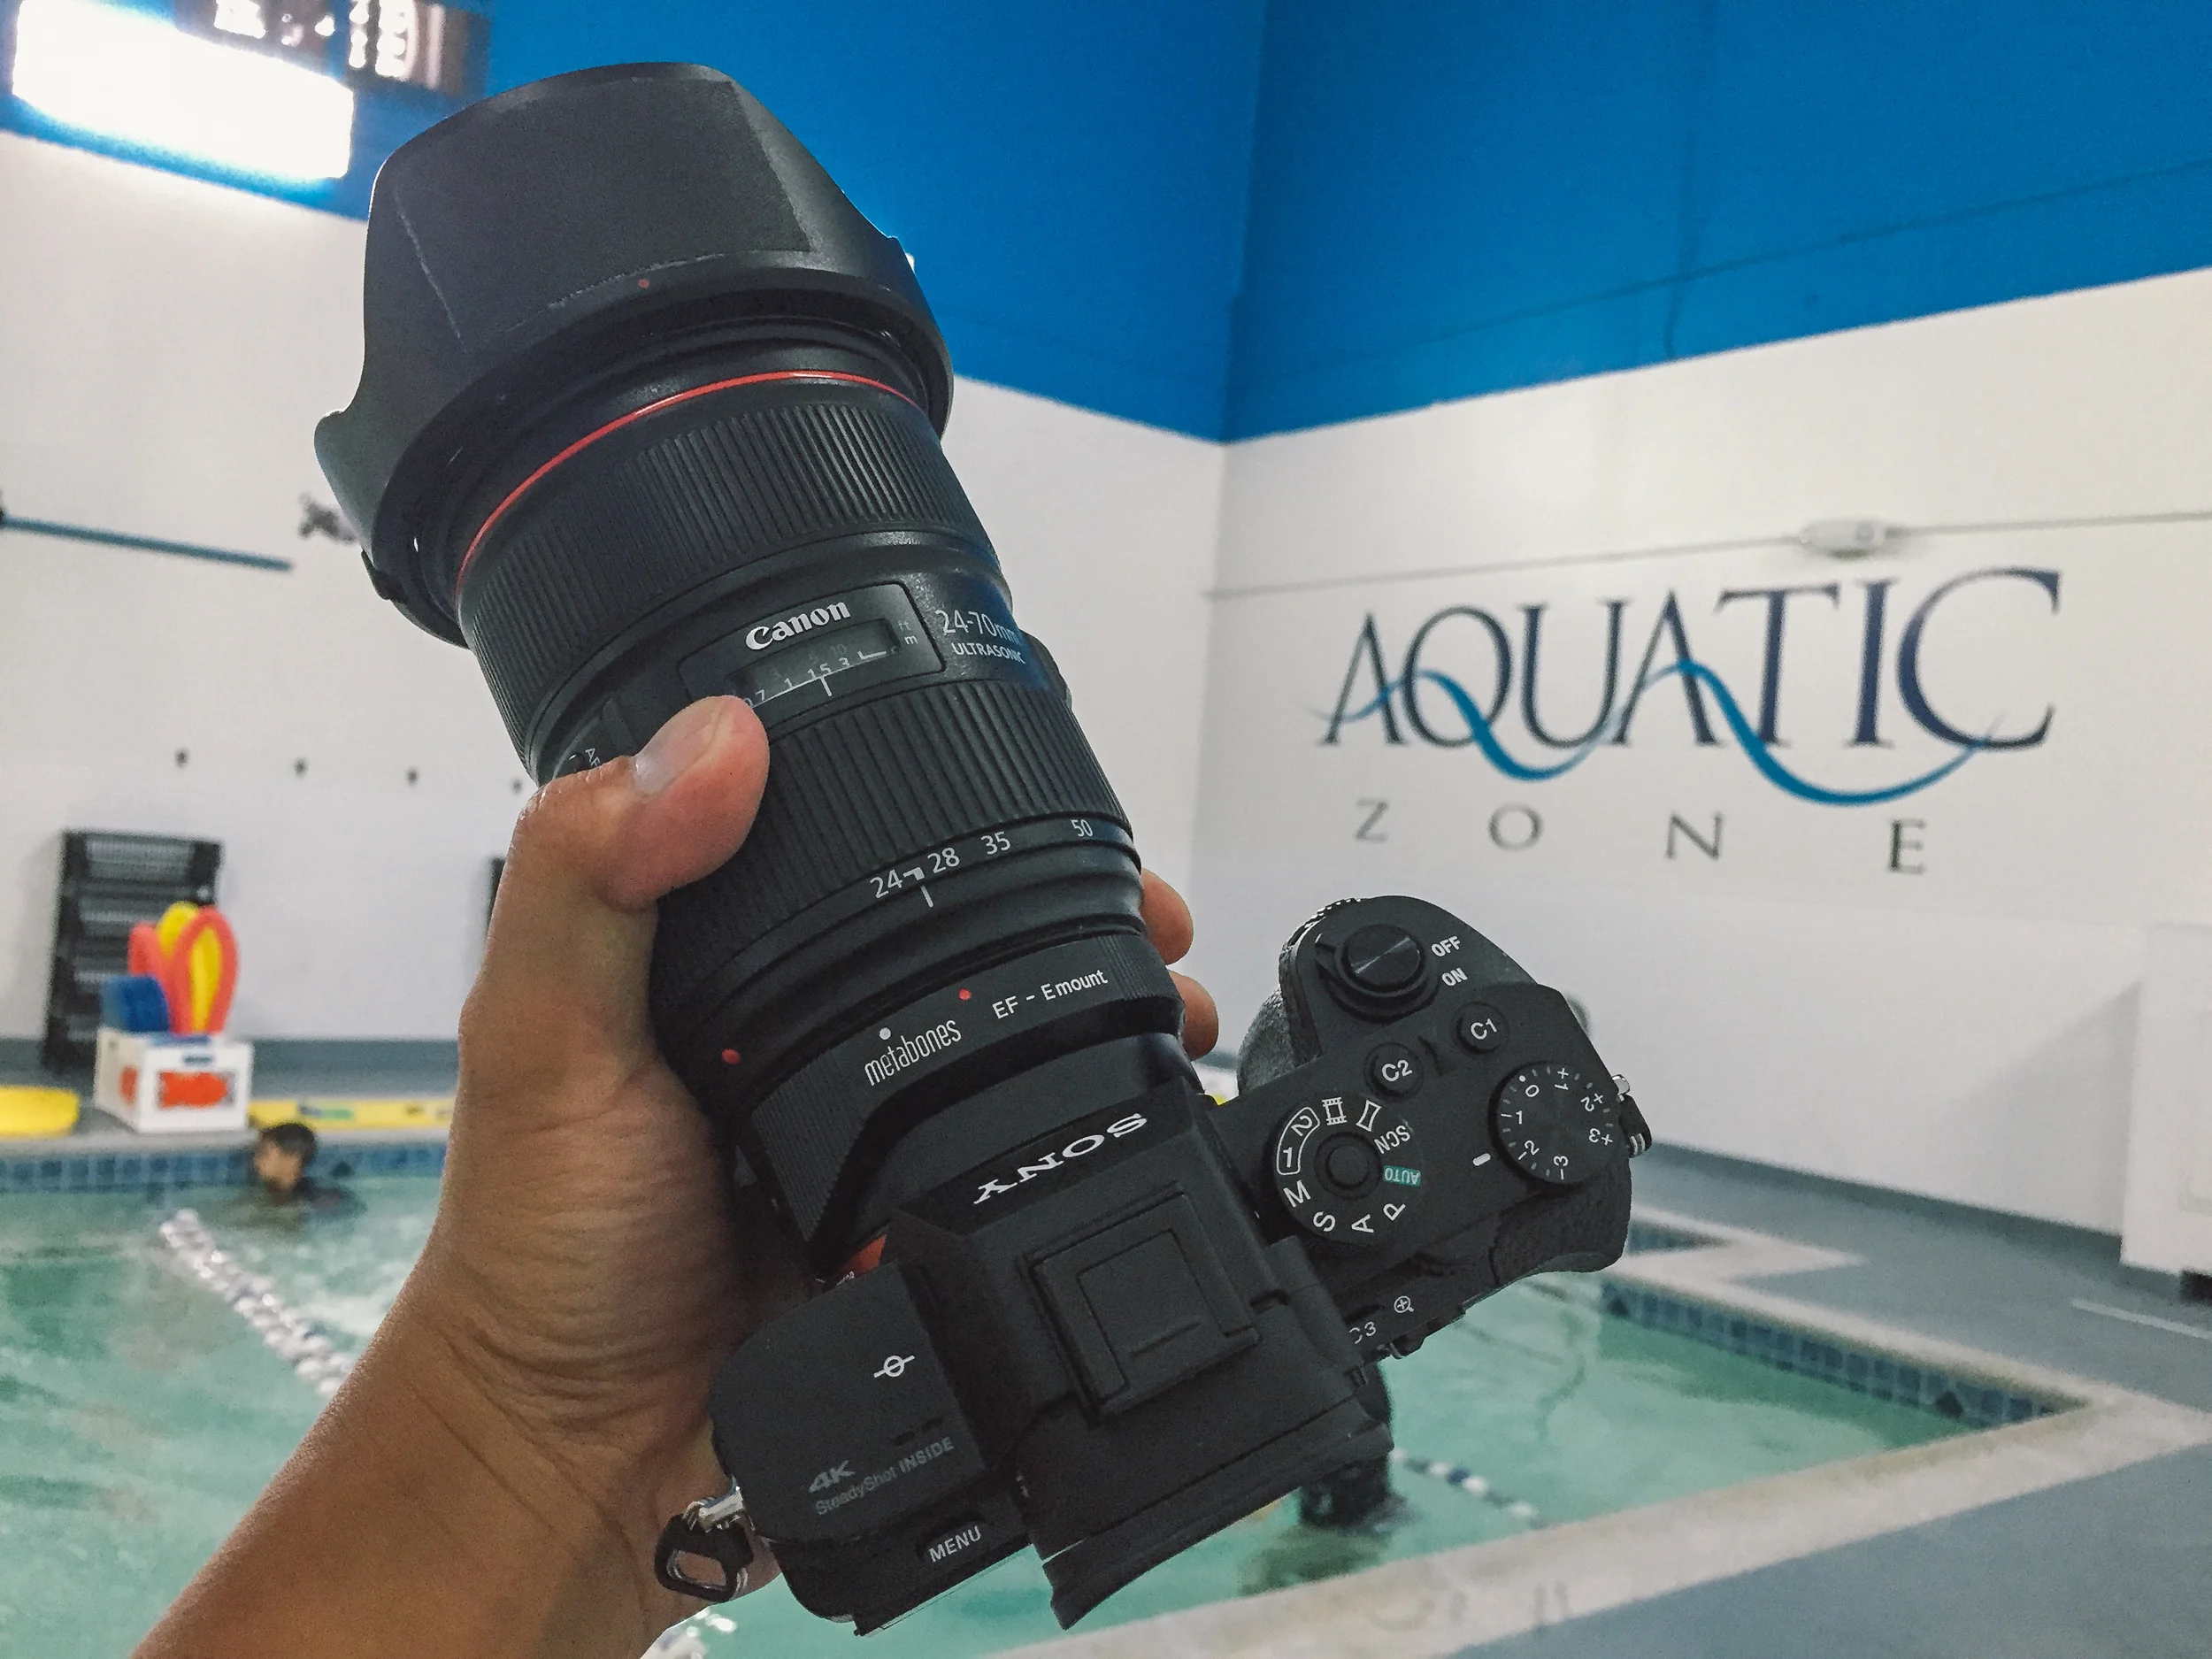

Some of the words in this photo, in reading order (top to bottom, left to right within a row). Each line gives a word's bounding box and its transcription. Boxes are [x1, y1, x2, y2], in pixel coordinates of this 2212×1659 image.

[745, 602, 851, 651] Canon
[904, 634, 918, 645] m
[950, 642, 1025, 664] ULTRASONIC
[1315, 565, 2062, 793] AQUATIC
[1354, 798, 1929, 874] ZONE
[869, 869, 903, 899] 24
[926, 847, 961, 874] 28
[979, 831, 1011, 856] 35
[1070, 818, 1094, 838] 50
[1431, 935, 1461, 957] OFF
[1440, 967, 1469, 987] ON
[992, 995, 1020, 1019] EF
[1470, 1018, 1498, 1041] C1
[864, 1018, 962, 1087] metabones
[1381, 1059, 1413, 1082] C2
[1525, 1084, 1540, 1098] 0
[1291, 1115, 1313, 1137] 2
[1373, 1125, 1411, 1155] SCN
[973, 1112, 1148, 1205] SONY
[1282, 1147, 1294, 1168] 1
[1384, 1167, 1421, 1186] AUTO
[1283, 1179, 1311, 1208] M
[1313, 1211, 1336, 1232] S
[1383, 1202, 1406, 1221] P
[1351, 1214, 1375, 1233] A
[809, 1460, 856, 1493] 4K
[816, 1466, 897, 1516] SteadyShot
[898, 1437, 955, 1474] INSIDE
[929, 1525, 982, 1563] MENU
